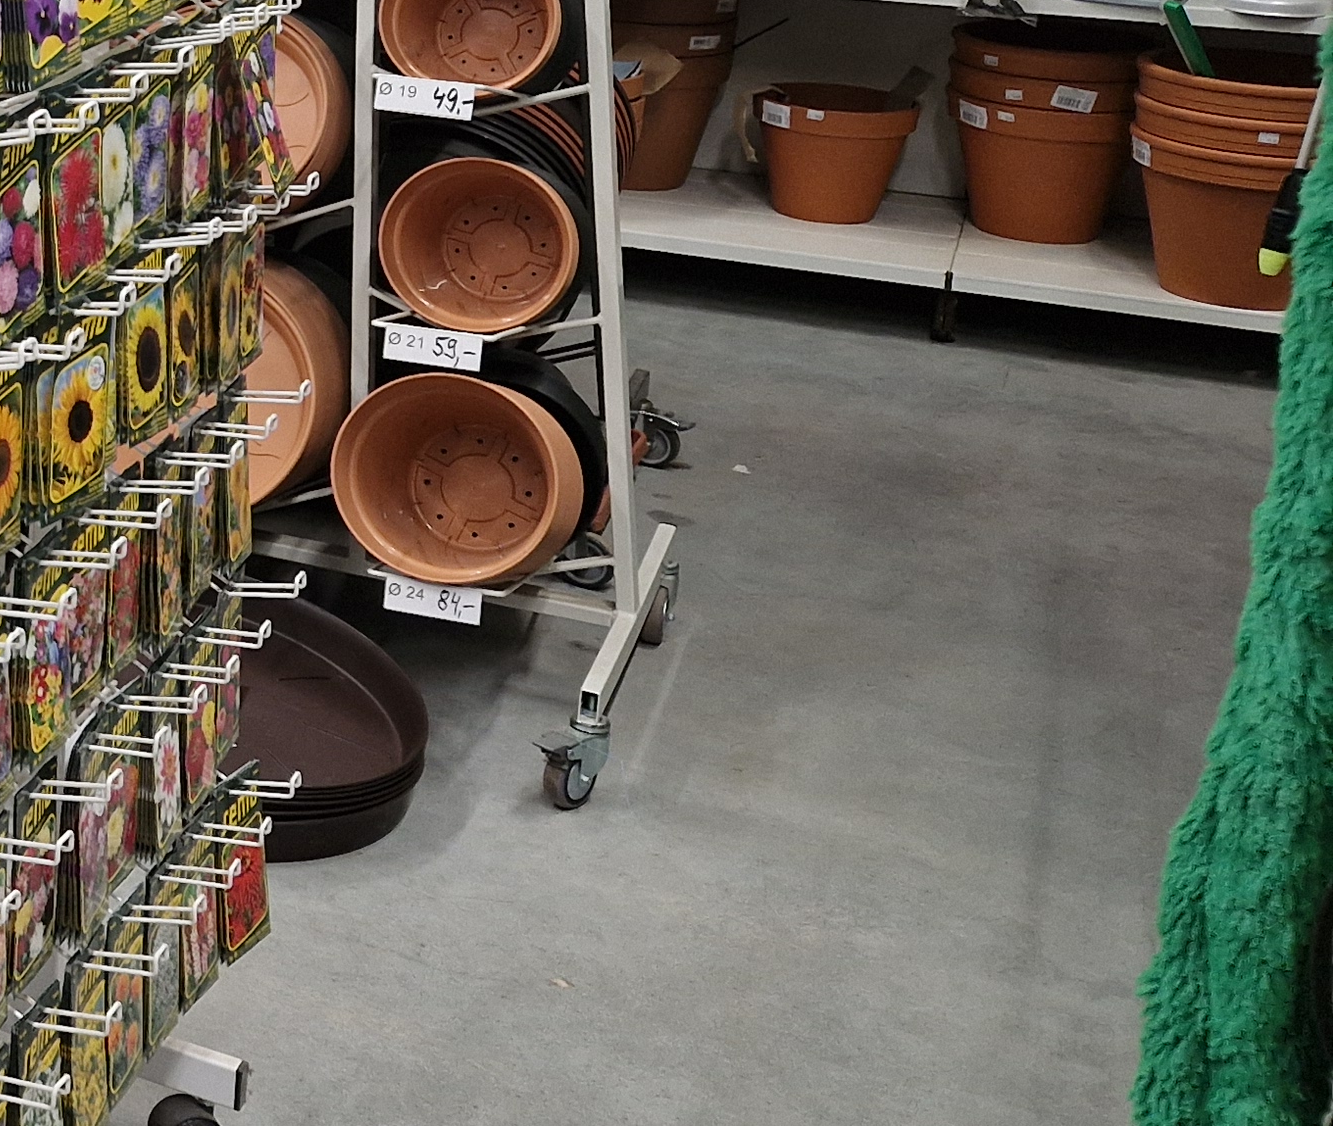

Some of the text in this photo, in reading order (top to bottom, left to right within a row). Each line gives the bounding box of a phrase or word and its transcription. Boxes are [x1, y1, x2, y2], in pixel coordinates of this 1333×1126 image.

[399, 86, 417, 98] 19
[406, 335, 424, 349] 21
[406, 586, 424, 601] 24
